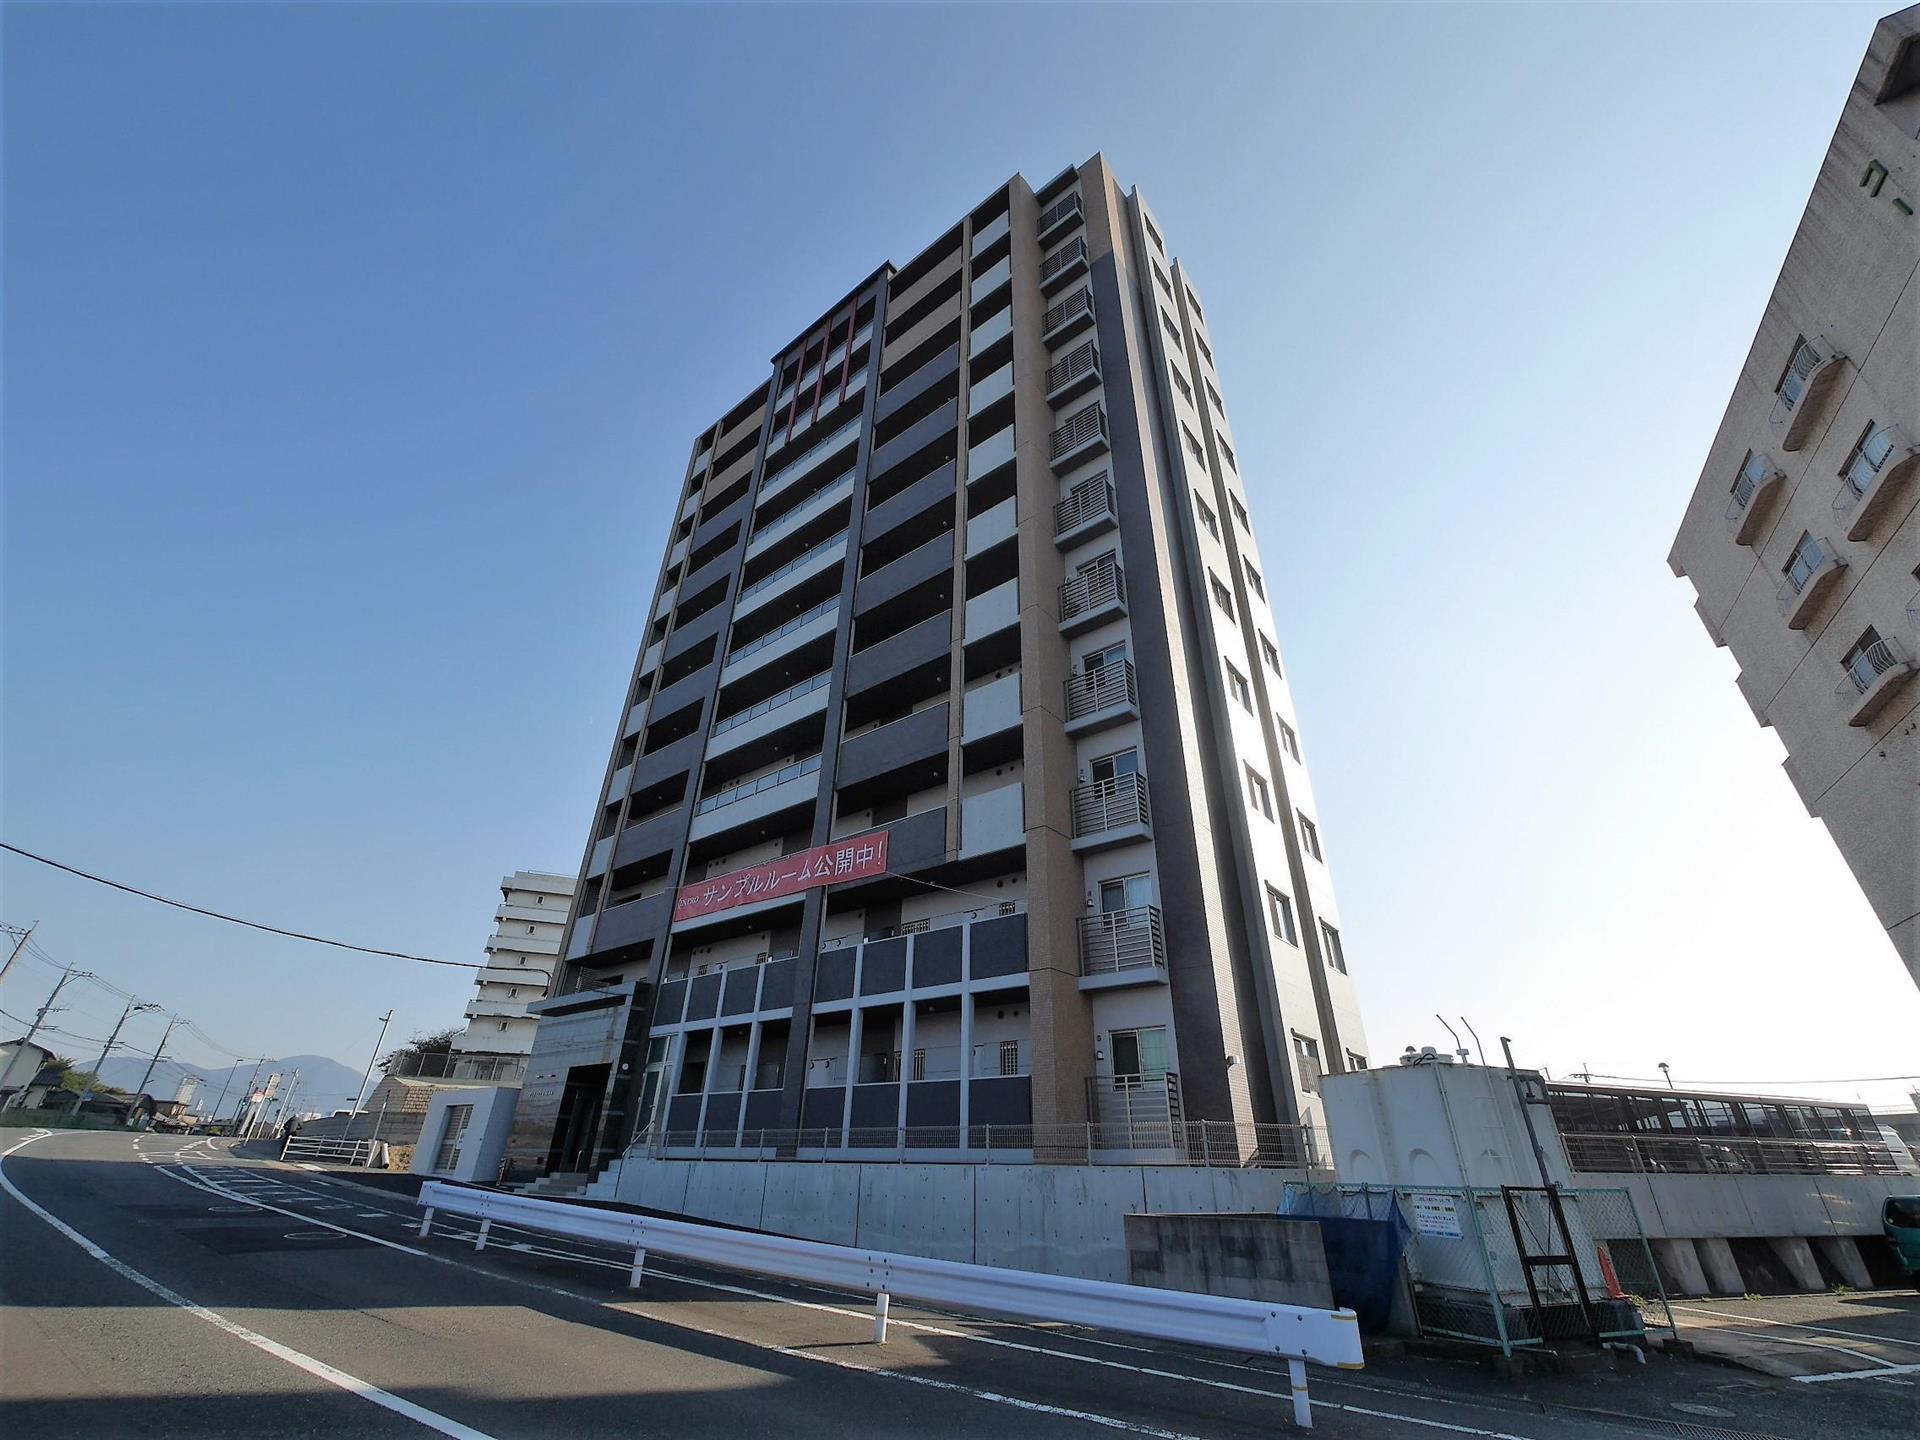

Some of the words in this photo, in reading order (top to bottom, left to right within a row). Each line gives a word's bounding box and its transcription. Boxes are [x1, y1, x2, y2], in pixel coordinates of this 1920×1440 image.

[703, 841, 883, 906] サンプルルーム公開中!
